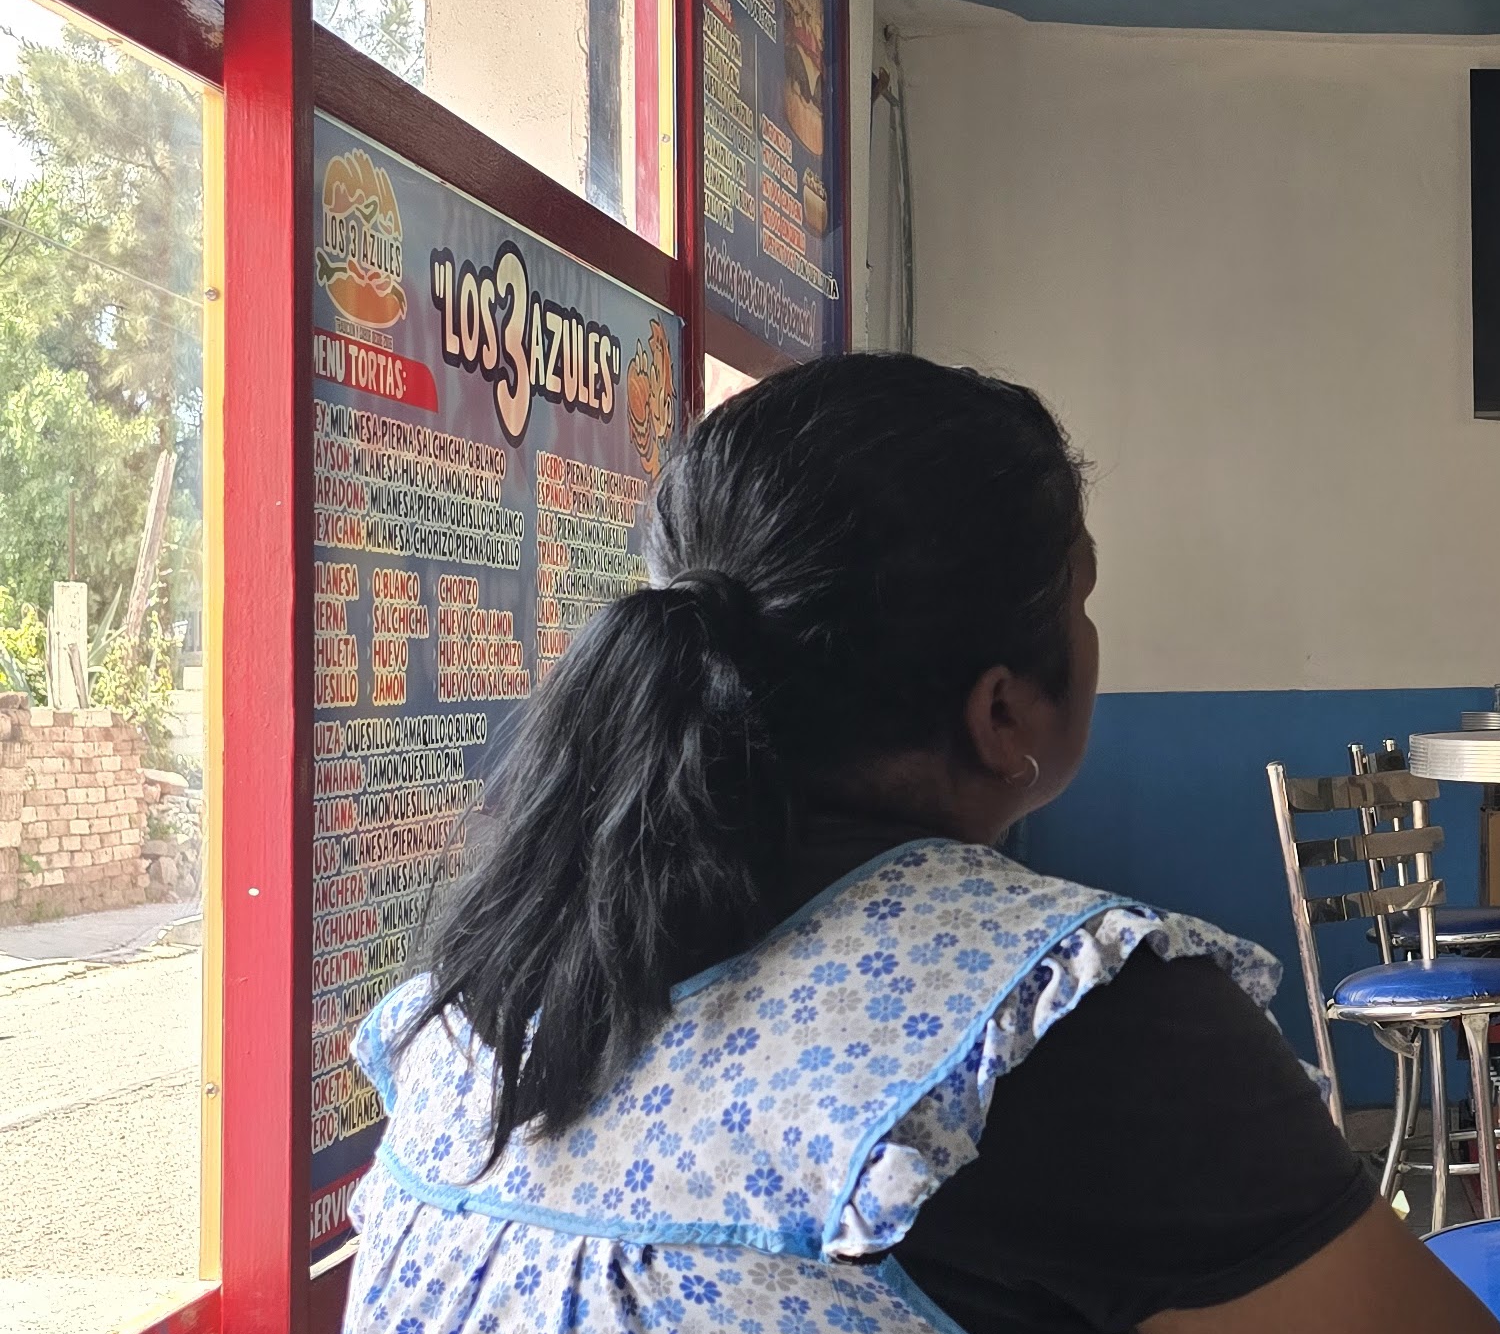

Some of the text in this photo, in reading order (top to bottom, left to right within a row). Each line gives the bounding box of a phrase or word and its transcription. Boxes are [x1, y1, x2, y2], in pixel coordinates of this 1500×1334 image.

[324, 210, 401, 279] LOS 3 AZULES
[496, 244, 530, 442] 3
[348, 341, 407, 403] TORTAS:
[439, 575, 478, 607] CHORIZO
[373, 604, 428, 637] SALCHICHA
[439, 607, 513, 639] HUEVO CON JAMON
[373, 640, 407, 670] HUEVO
[439, 639, 522, 670] HUEVO CON CHORIZO
[373, 673, 405, 703] JAMON
[439, 670, 531, 700] HUEVO CON SALCHICHA
